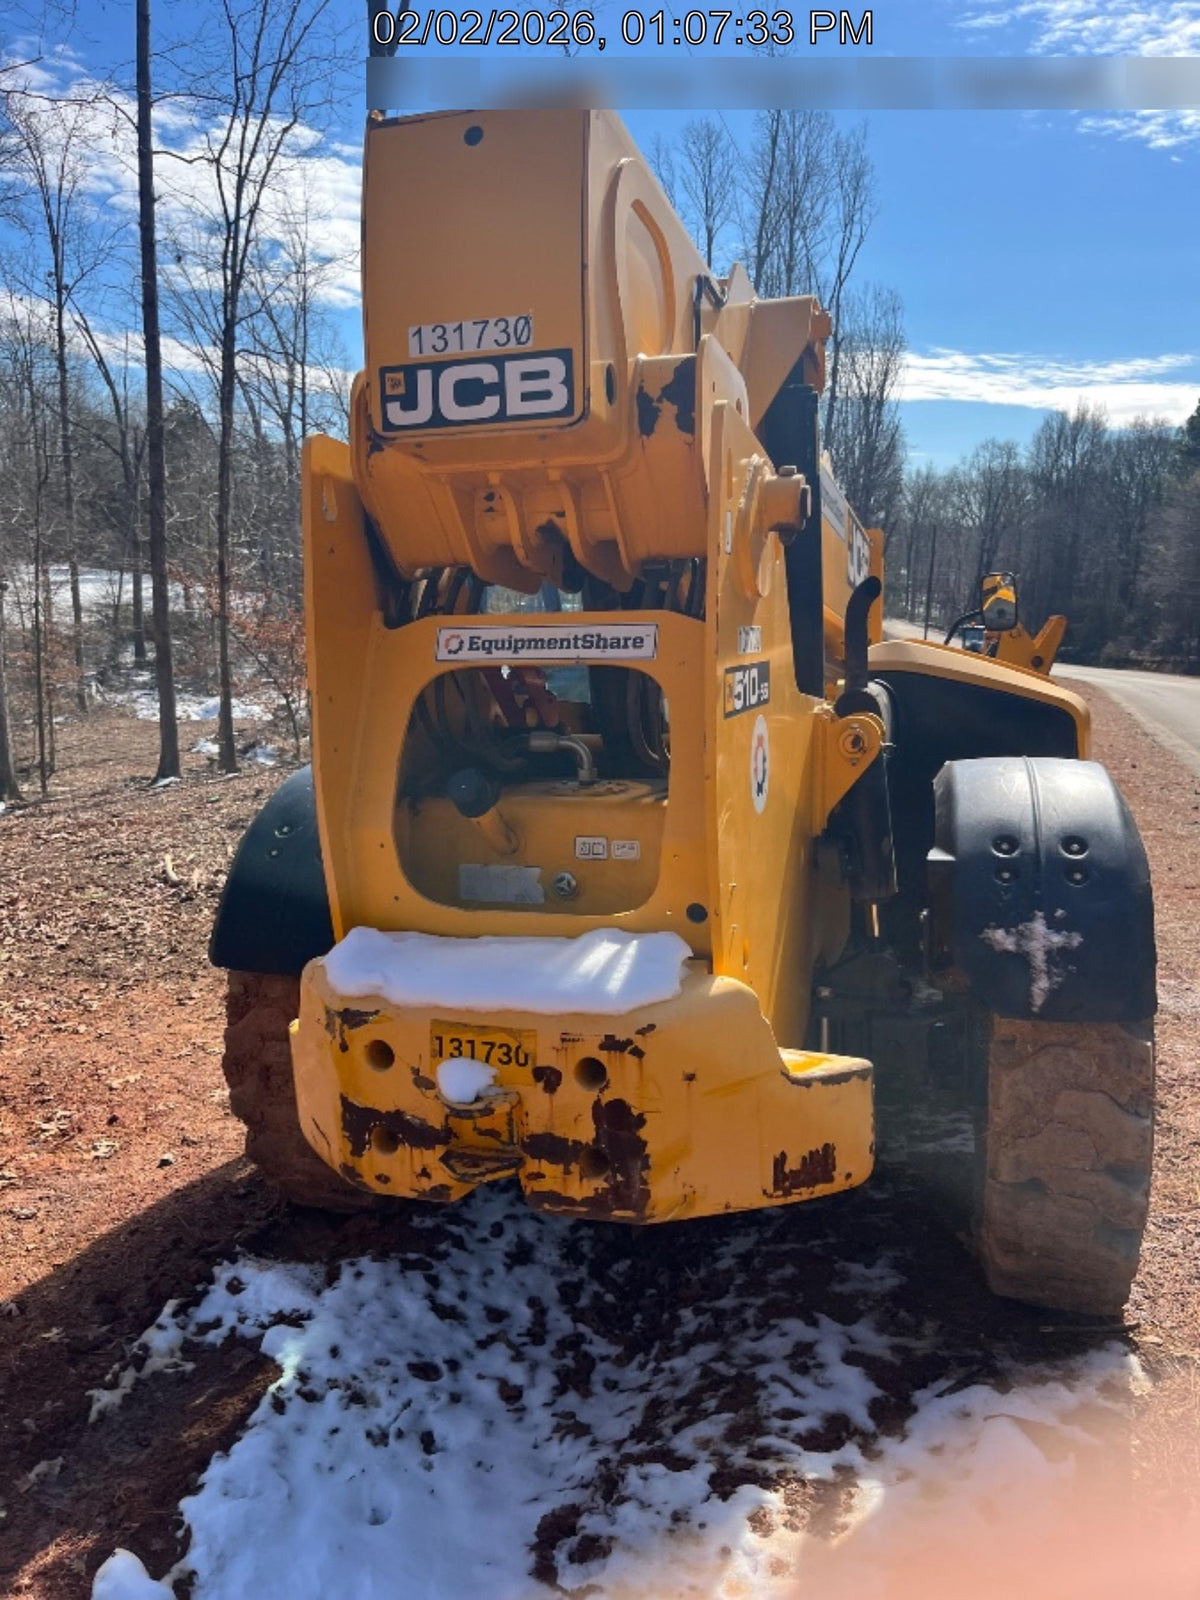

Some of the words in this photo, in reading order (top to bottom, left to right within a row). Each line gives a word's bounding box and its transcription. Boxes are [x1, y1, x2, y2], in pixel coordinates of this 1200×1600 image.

[411, 315, 533, 355] 131730
[386, 357, 569, 426] JCB
[467, 633, 645, 655] EquipmentShare
[434, 1036, 529, 1067] 131730
